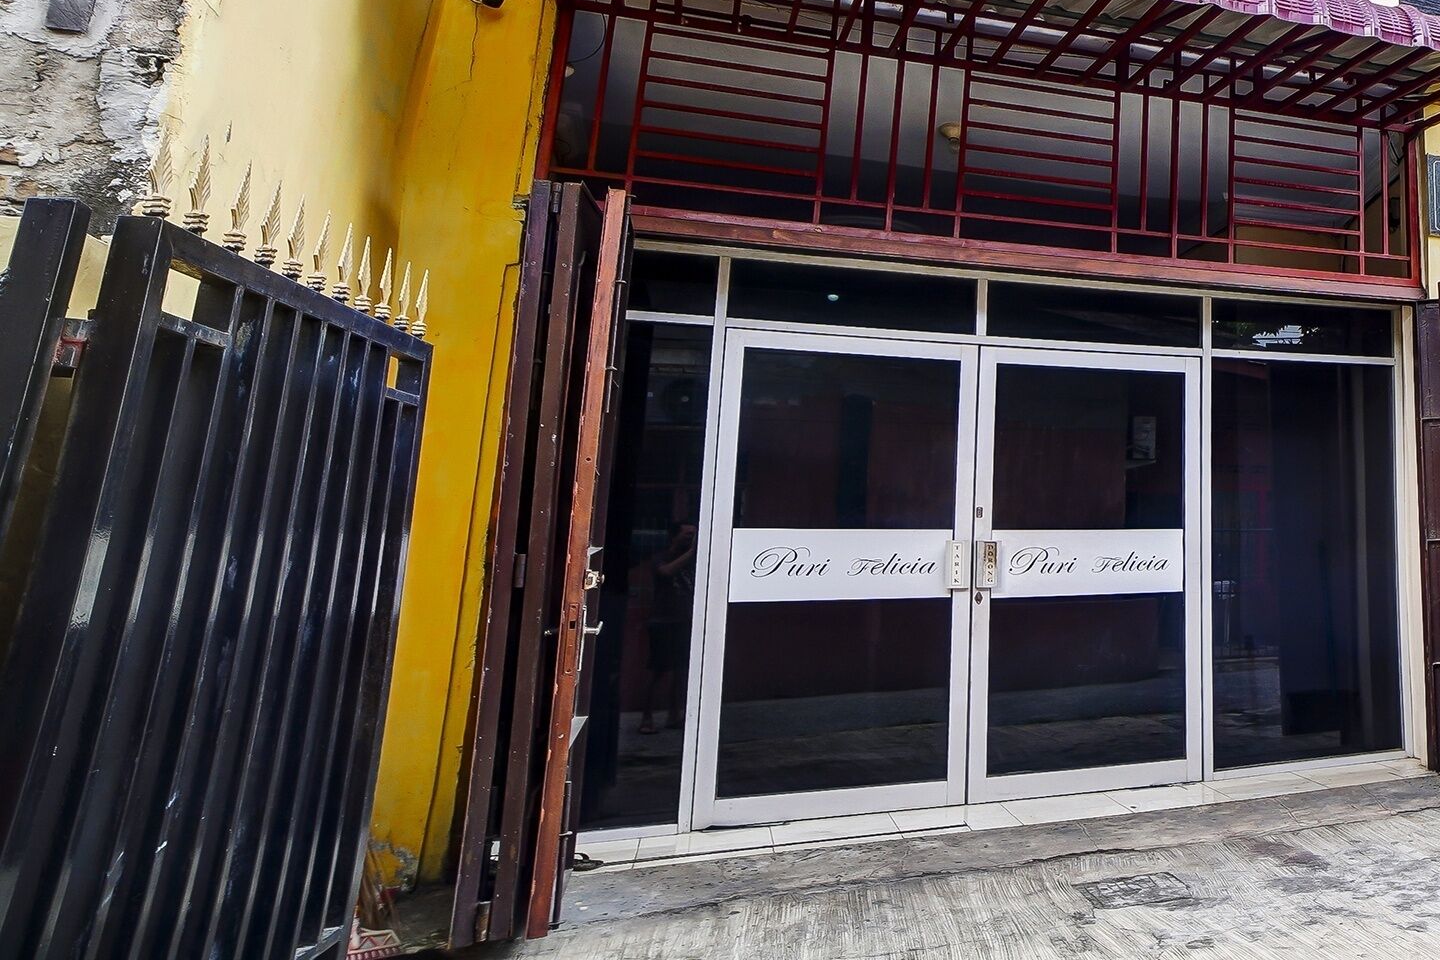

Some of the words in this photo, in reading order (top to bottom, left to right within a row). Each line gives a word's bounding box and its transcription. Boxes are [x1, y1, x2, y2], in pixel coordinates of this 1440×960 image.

[750, 546, 831, 579] Puri
[847, 552, 939, 577] Felicia
[1008, 546, 1078, 576] Puri
[1091, 551, 1171, 574] Felicia
